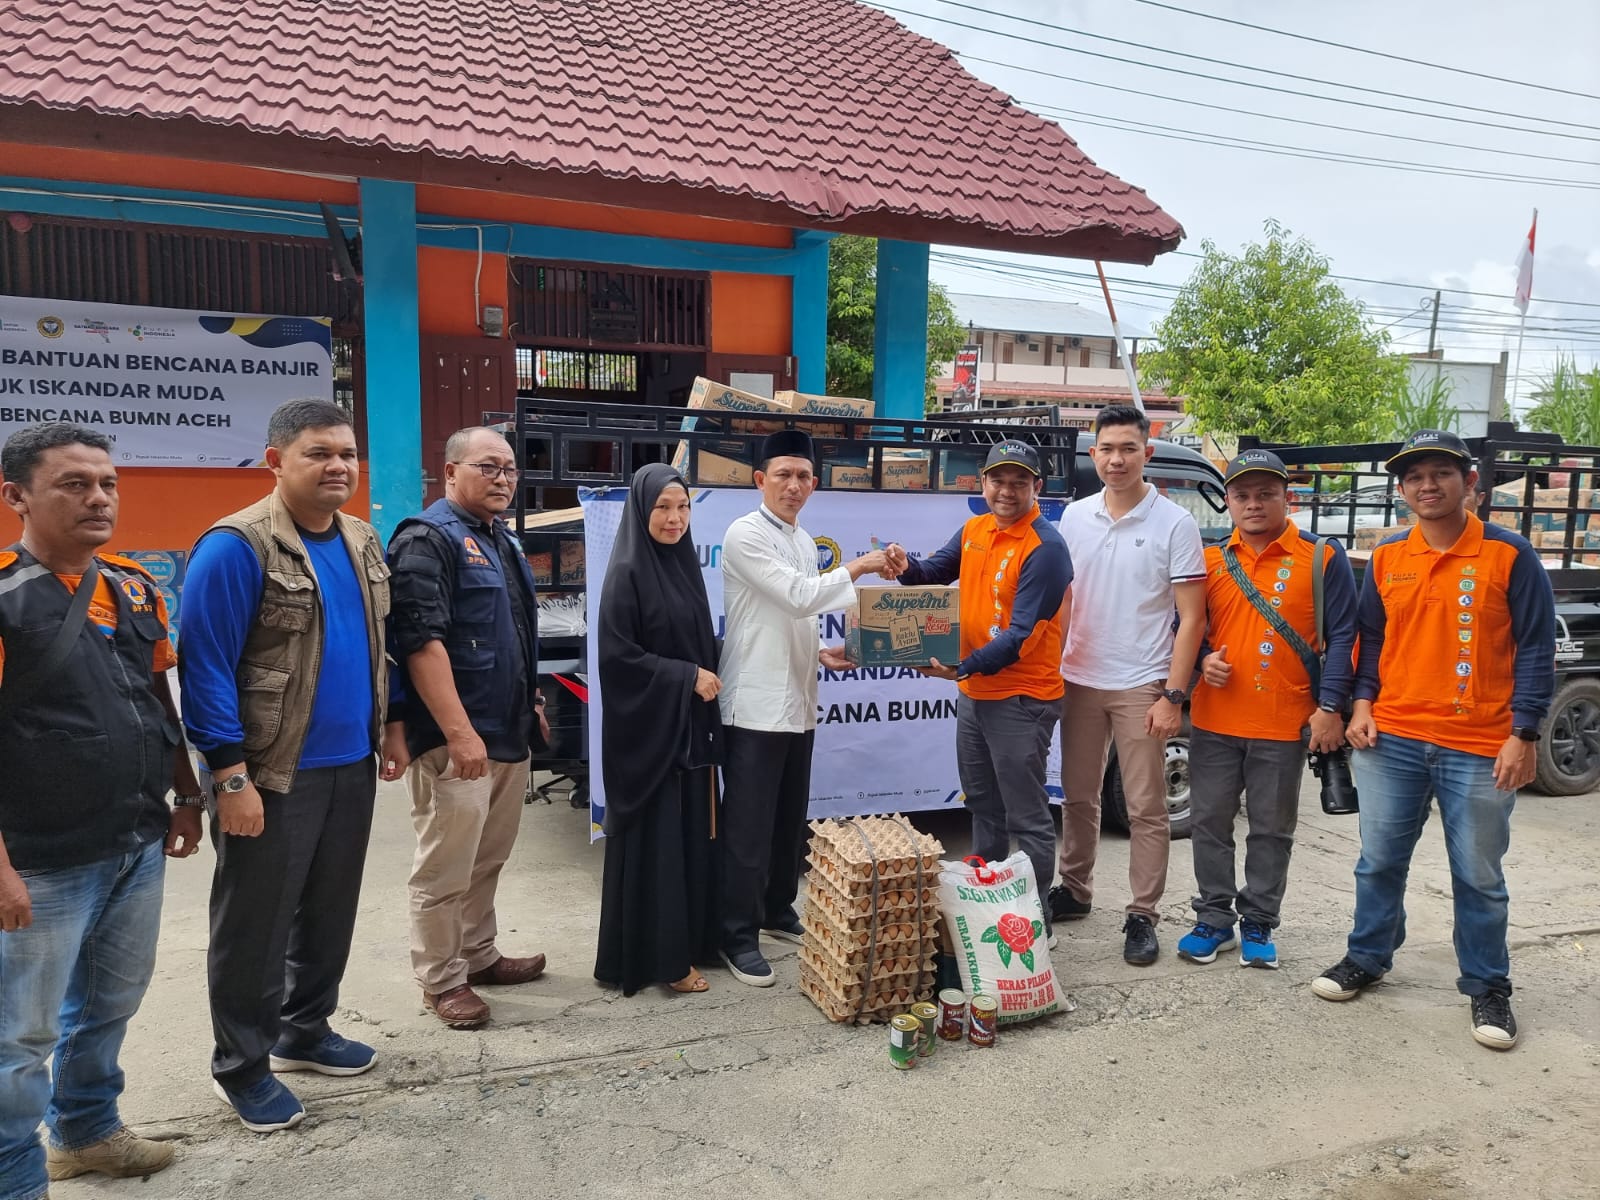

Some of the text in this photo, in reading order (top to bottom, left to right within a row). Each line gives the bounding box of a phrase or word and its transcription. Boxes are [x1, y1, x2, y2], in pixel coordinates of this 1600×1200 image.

[2, 349, 319, 377] BANTUAN BENCANA BANJIR
[0, 378, 225, 401] UK ISKANDAR MUDA
[0, 407, 231, 428] BENCANA BUMN ACEH
[816, 700, 958, 725] CANA BUMN
[956, 915, 974, 950] BERAS
[997, 979, 1026, 990] BERAS
[1000, 991, 1033, 1003] BRUTTO
